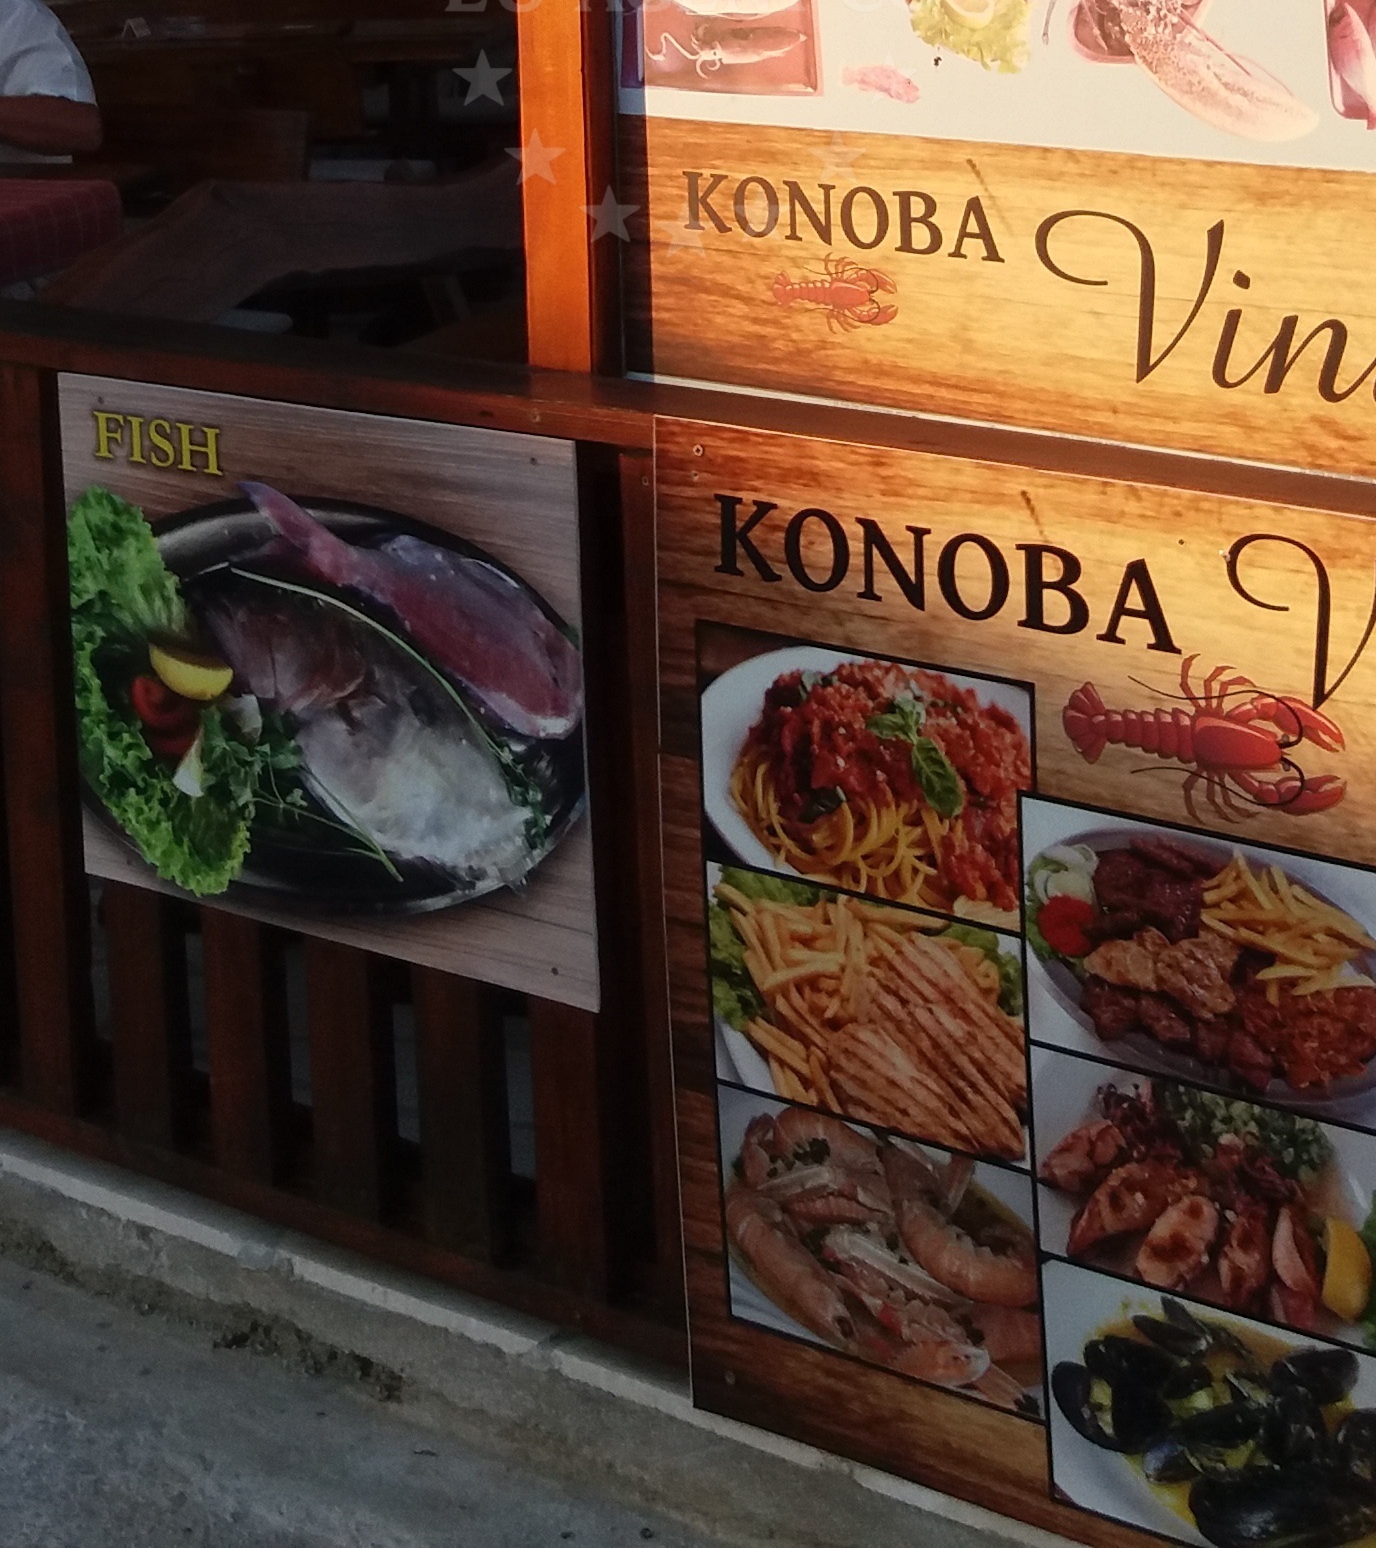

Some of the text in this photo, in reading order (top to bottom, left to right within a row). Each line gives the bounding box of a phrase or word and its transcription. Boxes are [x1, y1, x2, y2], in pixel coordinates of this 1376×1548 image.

[682, 169, 1006, 264] KONOBA
[93, 410, 224, 476] FISH
[713, 492, 1185, 654] KONOBA
